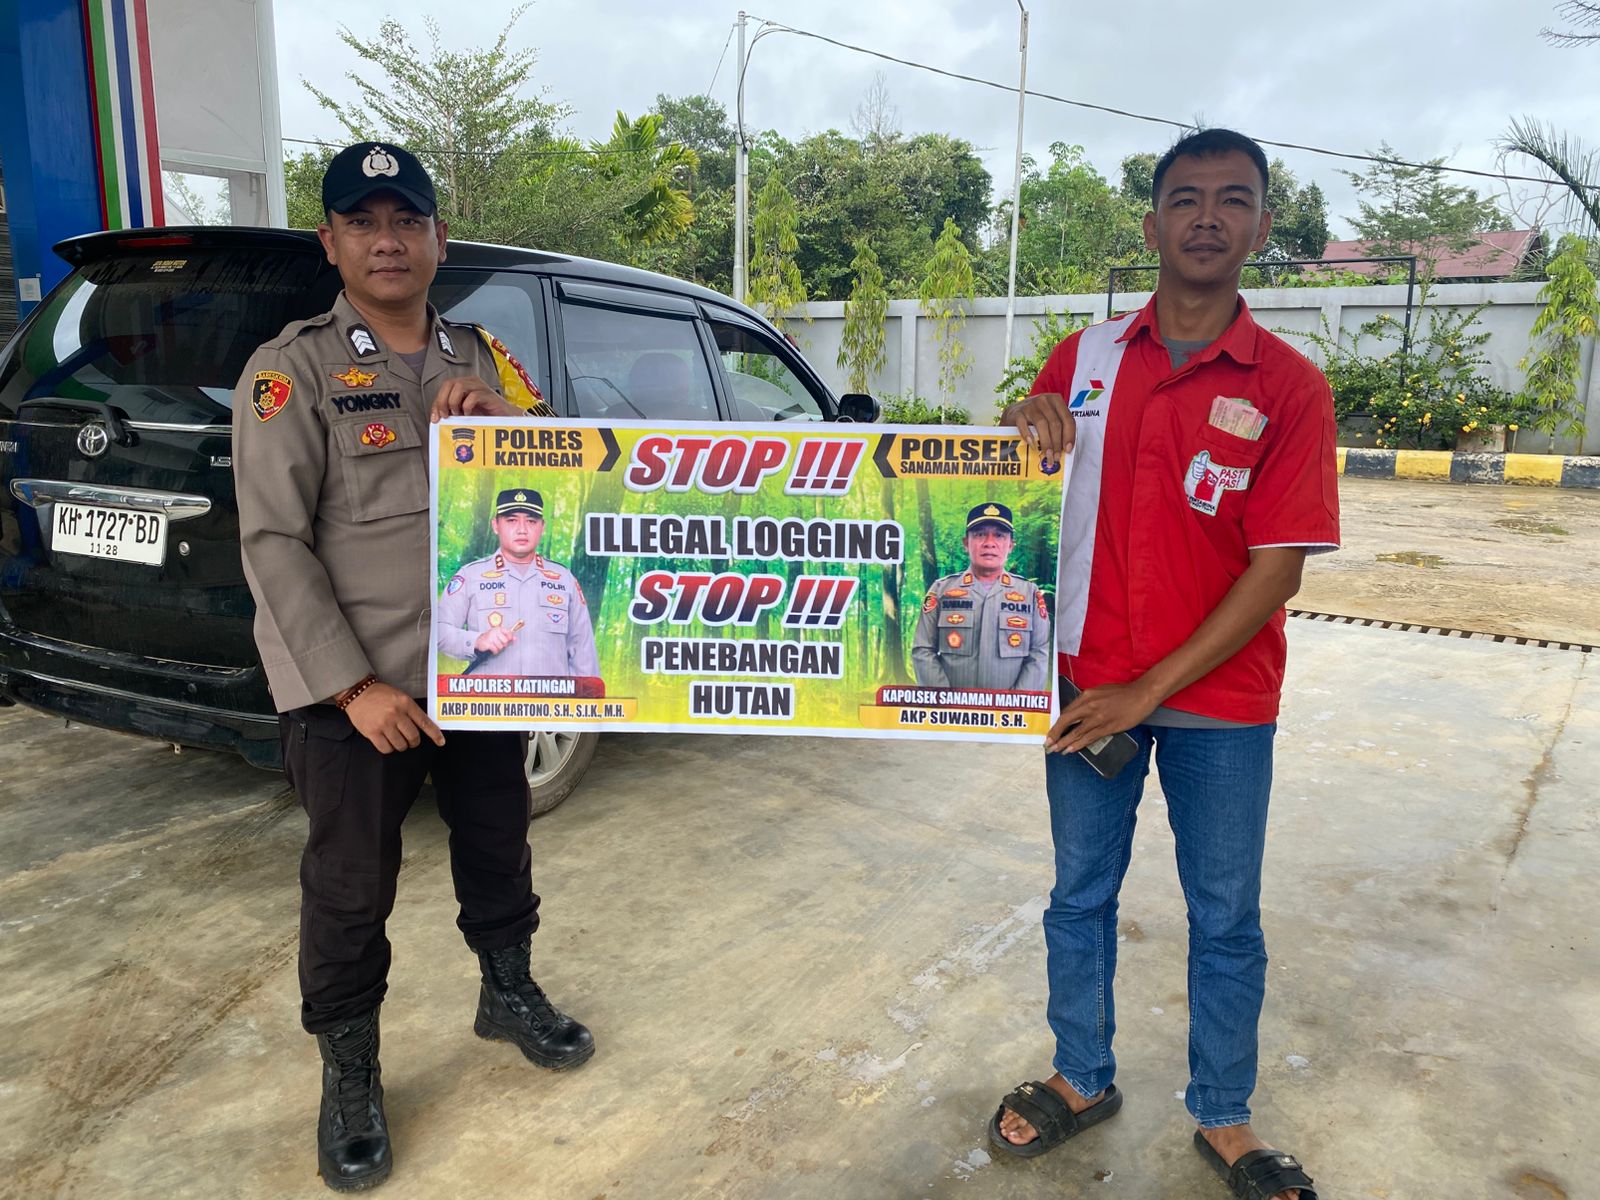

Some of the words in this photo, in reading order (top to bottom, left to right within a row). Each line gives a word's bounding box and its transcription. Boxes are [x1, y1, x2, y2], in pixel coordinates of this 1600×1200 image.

[331, 392, 400, 415] YONGKY
[1071, 410, 1100, 418] ERTAMINA
[495, 428, 583, 451] POLRES
[494, 451, 583, 468] KATINGAN
[900, 438, 1021, 462] POLSEK
[629, 437, 787, 490] STOP
[790, 440, 865, 490] !!!
[900, 461, 959, 475] SANAMAN
[961, 461, 1021, 476] MANTIKEI
[59, 506, 78, 536] KH
[85, 509, 129, 542] 1727
[135, 514, 160, 545] BD
[589, 516, 727, 556] ILLEGAL
[737, 520, 901, 561] LOGGING
[479, 581, 506, 591] DODIK
[540, 581, 566, 592] POLRI
[631, 574, 783, 623] STOP
[785, 578, 856, 626] !!!
[1000, 602, 1031, 614] POLRI
[645, 640, 840, 675] PENEBANGAN
[449, 678, 512, 694] KAPOLRES
[514, 679, 575, 694] KATINGAN
[693, 685, 791, 716] HUTAN
[882, 689, 937, 705] KAPOLSEK
[939, 691, 993, 707] SANAMAN
[995, 693, 1049, 709] MANTIKEI
[441, 702, 468, 716] AKBP
[470, 703, 502, 717] DODIK
[503, 703, 553, 718] HARTONO,
[604, 705, 625, 718] M.H.
[900, 709, 927, 724] AKP
[930, 710, 997, 727] SUWARDI,
[1001, 713, 1027, 728] S.H.
